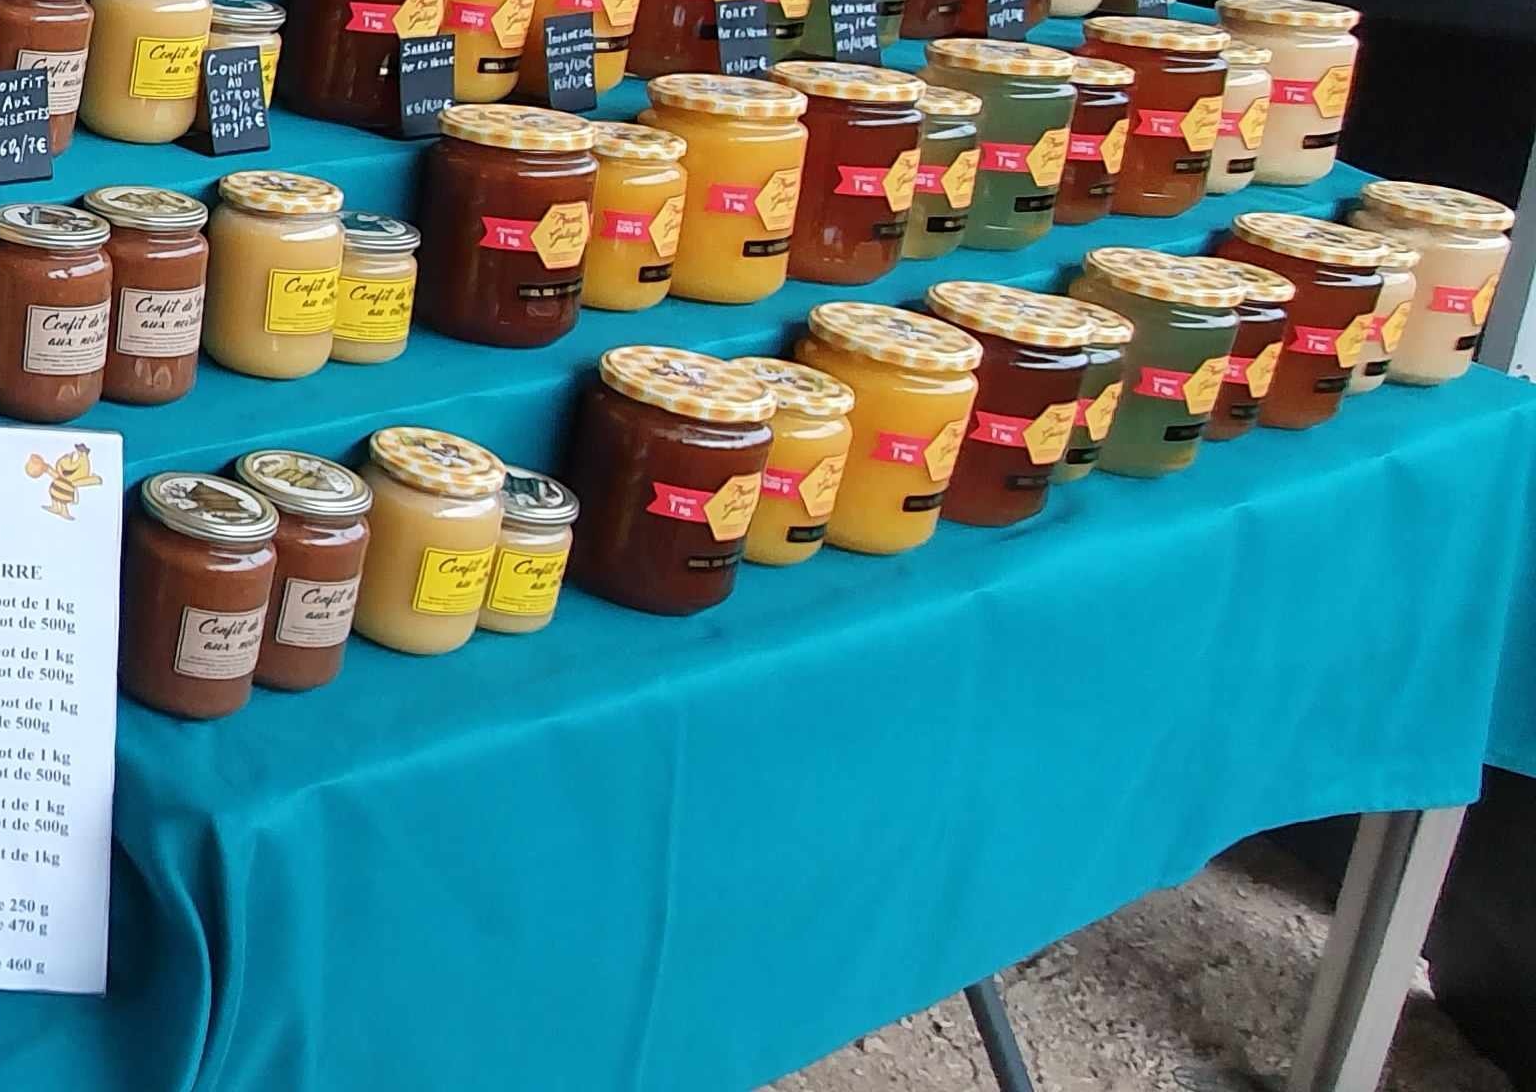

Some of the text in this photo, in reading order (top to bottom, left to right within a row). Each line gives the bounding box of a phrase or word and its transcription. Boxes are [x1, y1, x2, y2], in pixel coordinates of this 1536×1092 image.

[228, 77, 242, 88] AU
[349, 286, 393, 305] Confit
[135, 295, 180, 318] Confit
[42, 313, 84, 334] Confit
